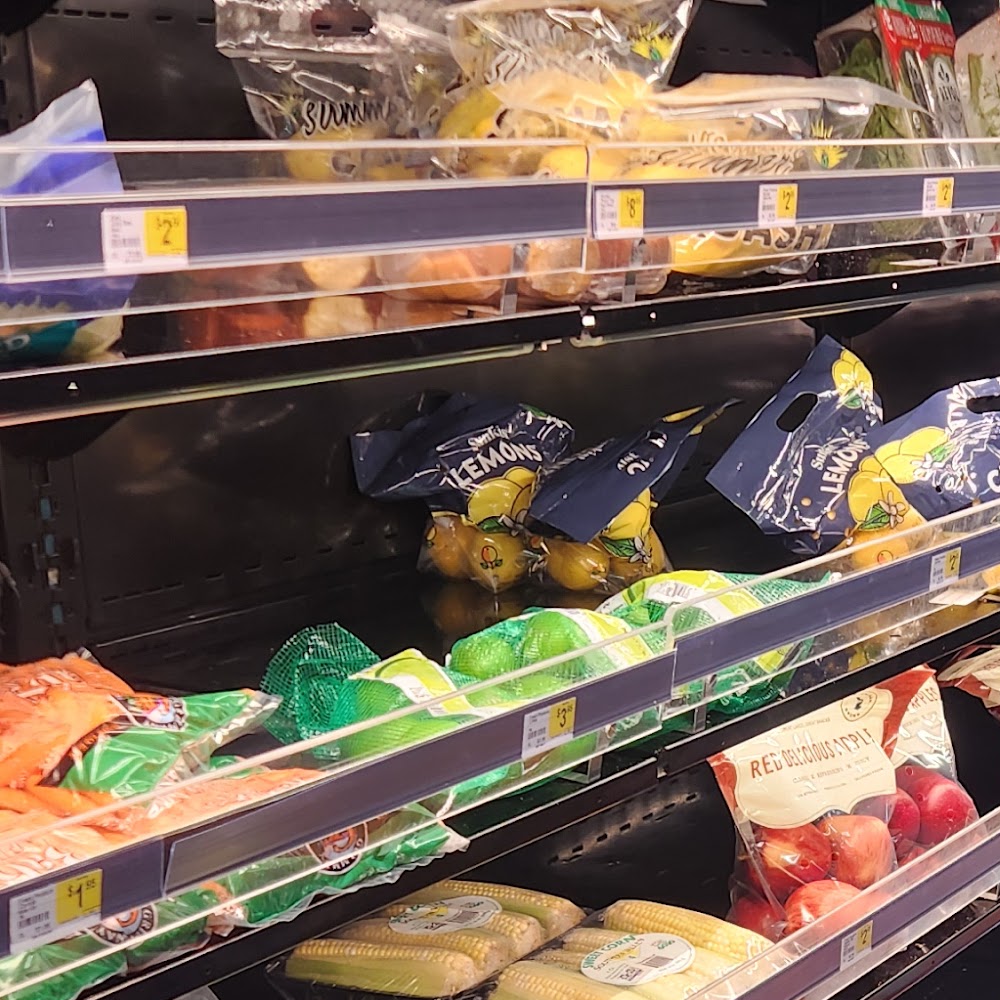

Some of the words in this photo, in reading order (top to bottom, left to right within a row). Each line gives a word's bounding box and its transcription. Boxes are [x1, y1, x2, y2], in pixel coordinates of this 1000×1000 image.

[449, 440, 543, 487] LEMONS
[750, 752, 784, 779] RED
[784, 739, 835, 768] DELICIOUS
[601, 934, 637, 954] CORN
